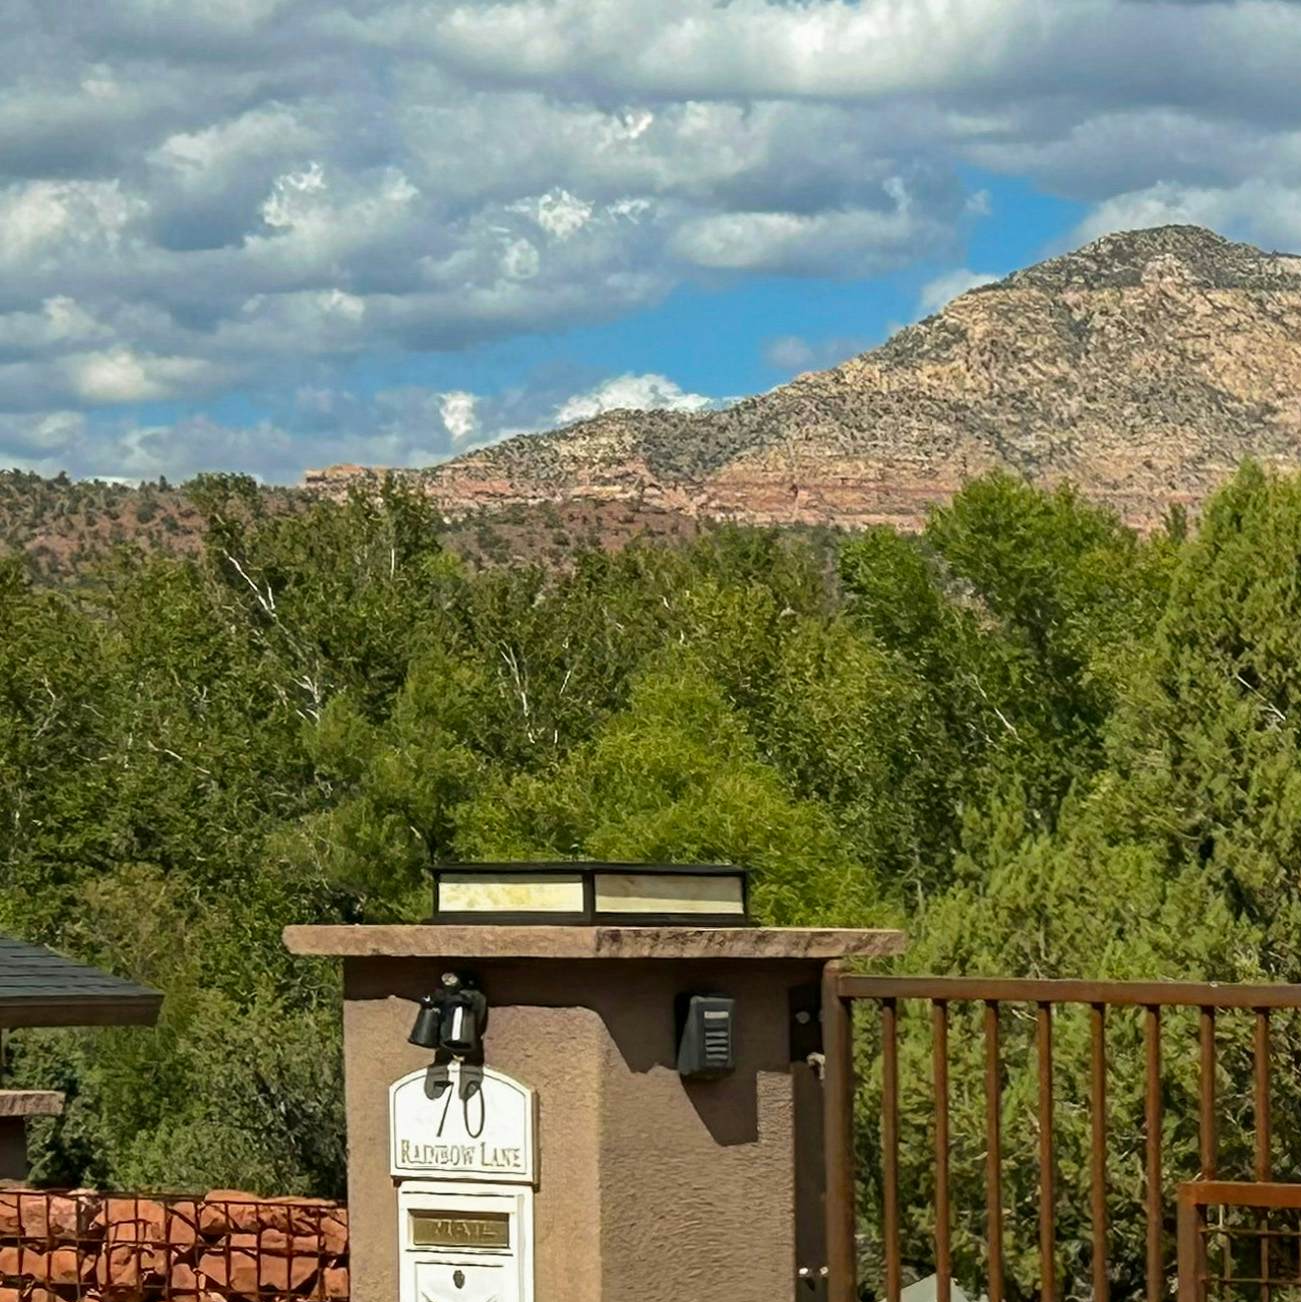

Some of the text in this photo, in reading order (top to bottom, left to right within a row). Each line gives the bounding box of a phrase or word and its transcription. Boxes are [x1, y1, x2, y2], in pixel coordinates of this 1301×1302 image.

[433, 1079, 485, 1139] 70
[401, 1139, 521, 1168] RAINBOW LANE
[432, 1219, 497, 1236] MAIL
